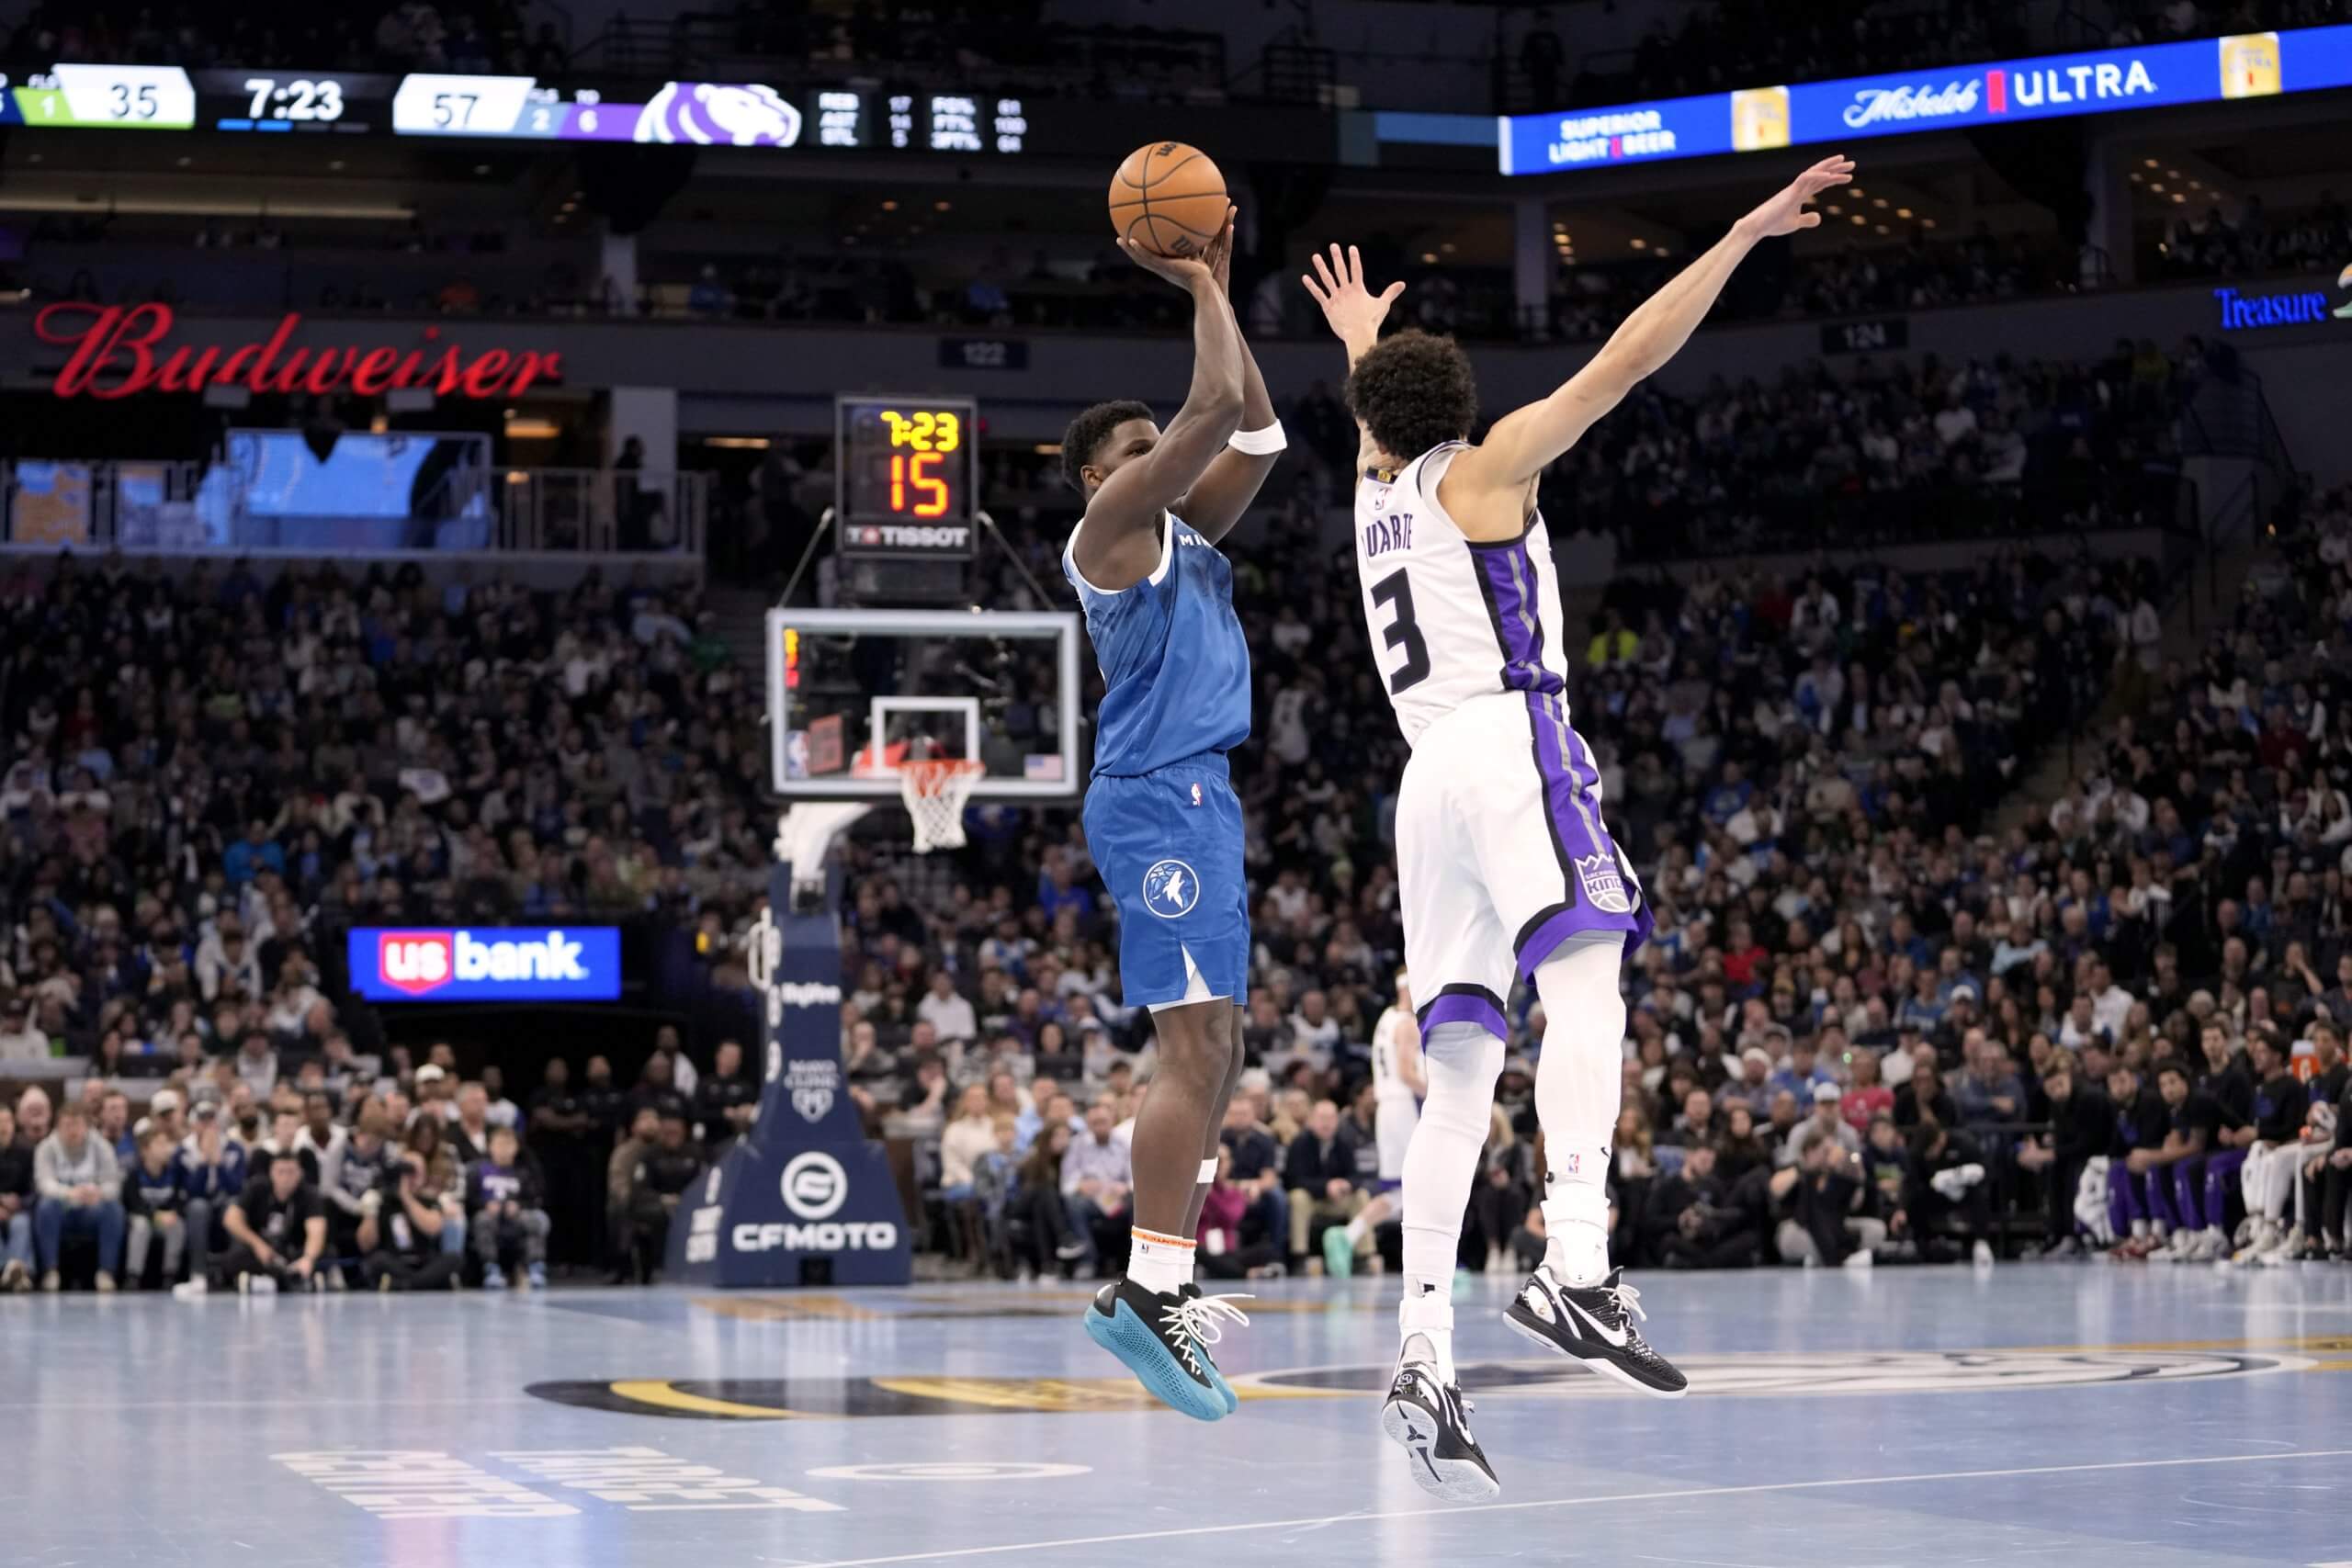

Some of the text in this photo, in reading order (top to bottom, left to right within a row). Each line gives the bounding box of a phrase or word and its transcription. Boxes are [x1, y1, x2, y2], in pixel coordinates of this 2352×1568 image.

[243, 78, 345, 121] 7:23
[2014, 60, 2154, 107] ULTRA
[40, 96, 56, 118] 1
[109, 84, 159, 119] 35
[434, 94, 480, 127] 57
[532, 108, 551, 131] 2
[579, 109, 598, 133] 6
[1560, 109, 1662, 141] SUPERIOR
[1548, 130, 1676, 164] LIGHT BEER
[2212, 288, 2328, 331] Treasure
[34, 301, 563, 400] Budweiser
[879, 410, 959, 452] 7:23
[890, 452, 949, 517] 15
[879, 526, 970, 547] TISSOT
[1362, 513, 1414, 558] UARTE
[1370, 567, 1431, 696] 3
[731, 1221, 898, 1251] CFMOTO
